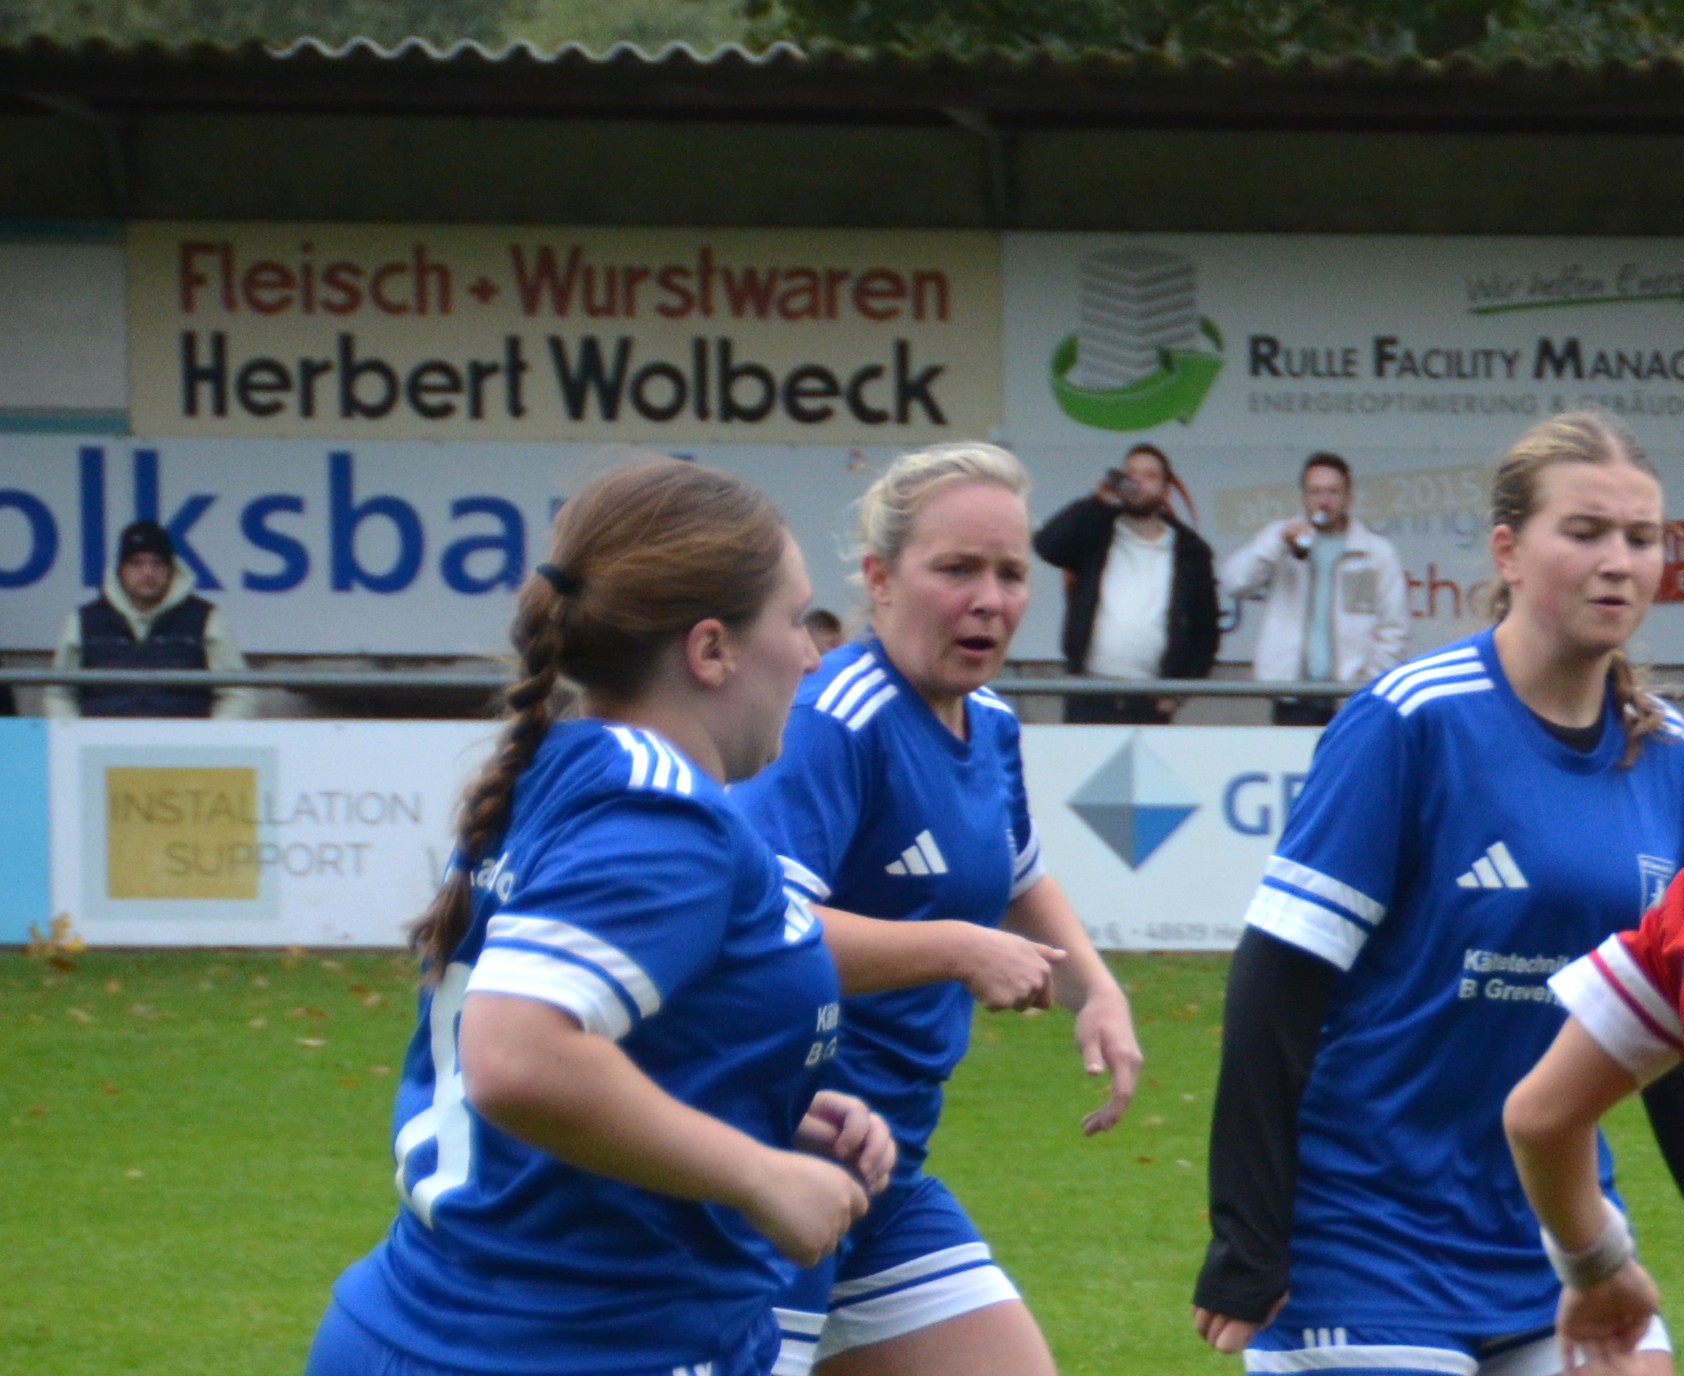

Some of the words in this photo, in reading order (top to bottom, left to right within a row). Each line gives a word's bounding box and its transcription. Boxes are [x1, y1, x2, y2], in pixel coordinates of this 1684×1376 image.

[180, 241, 453, 316] Fleisch
[511, 244, 949, 321] Wurstwaren
[183, 330, 528, 418] Herbert
[546, 335, 948, 425] Wolbeck
[1248, 334, 1357, 378] RULLE
[1372, 335, 1520, 380] FACILITY
[0, 446, 560, 595] olksba
[109, 789, 422, 826] INSTALLATION
[165, 841, 371, 878] SUPPORT
